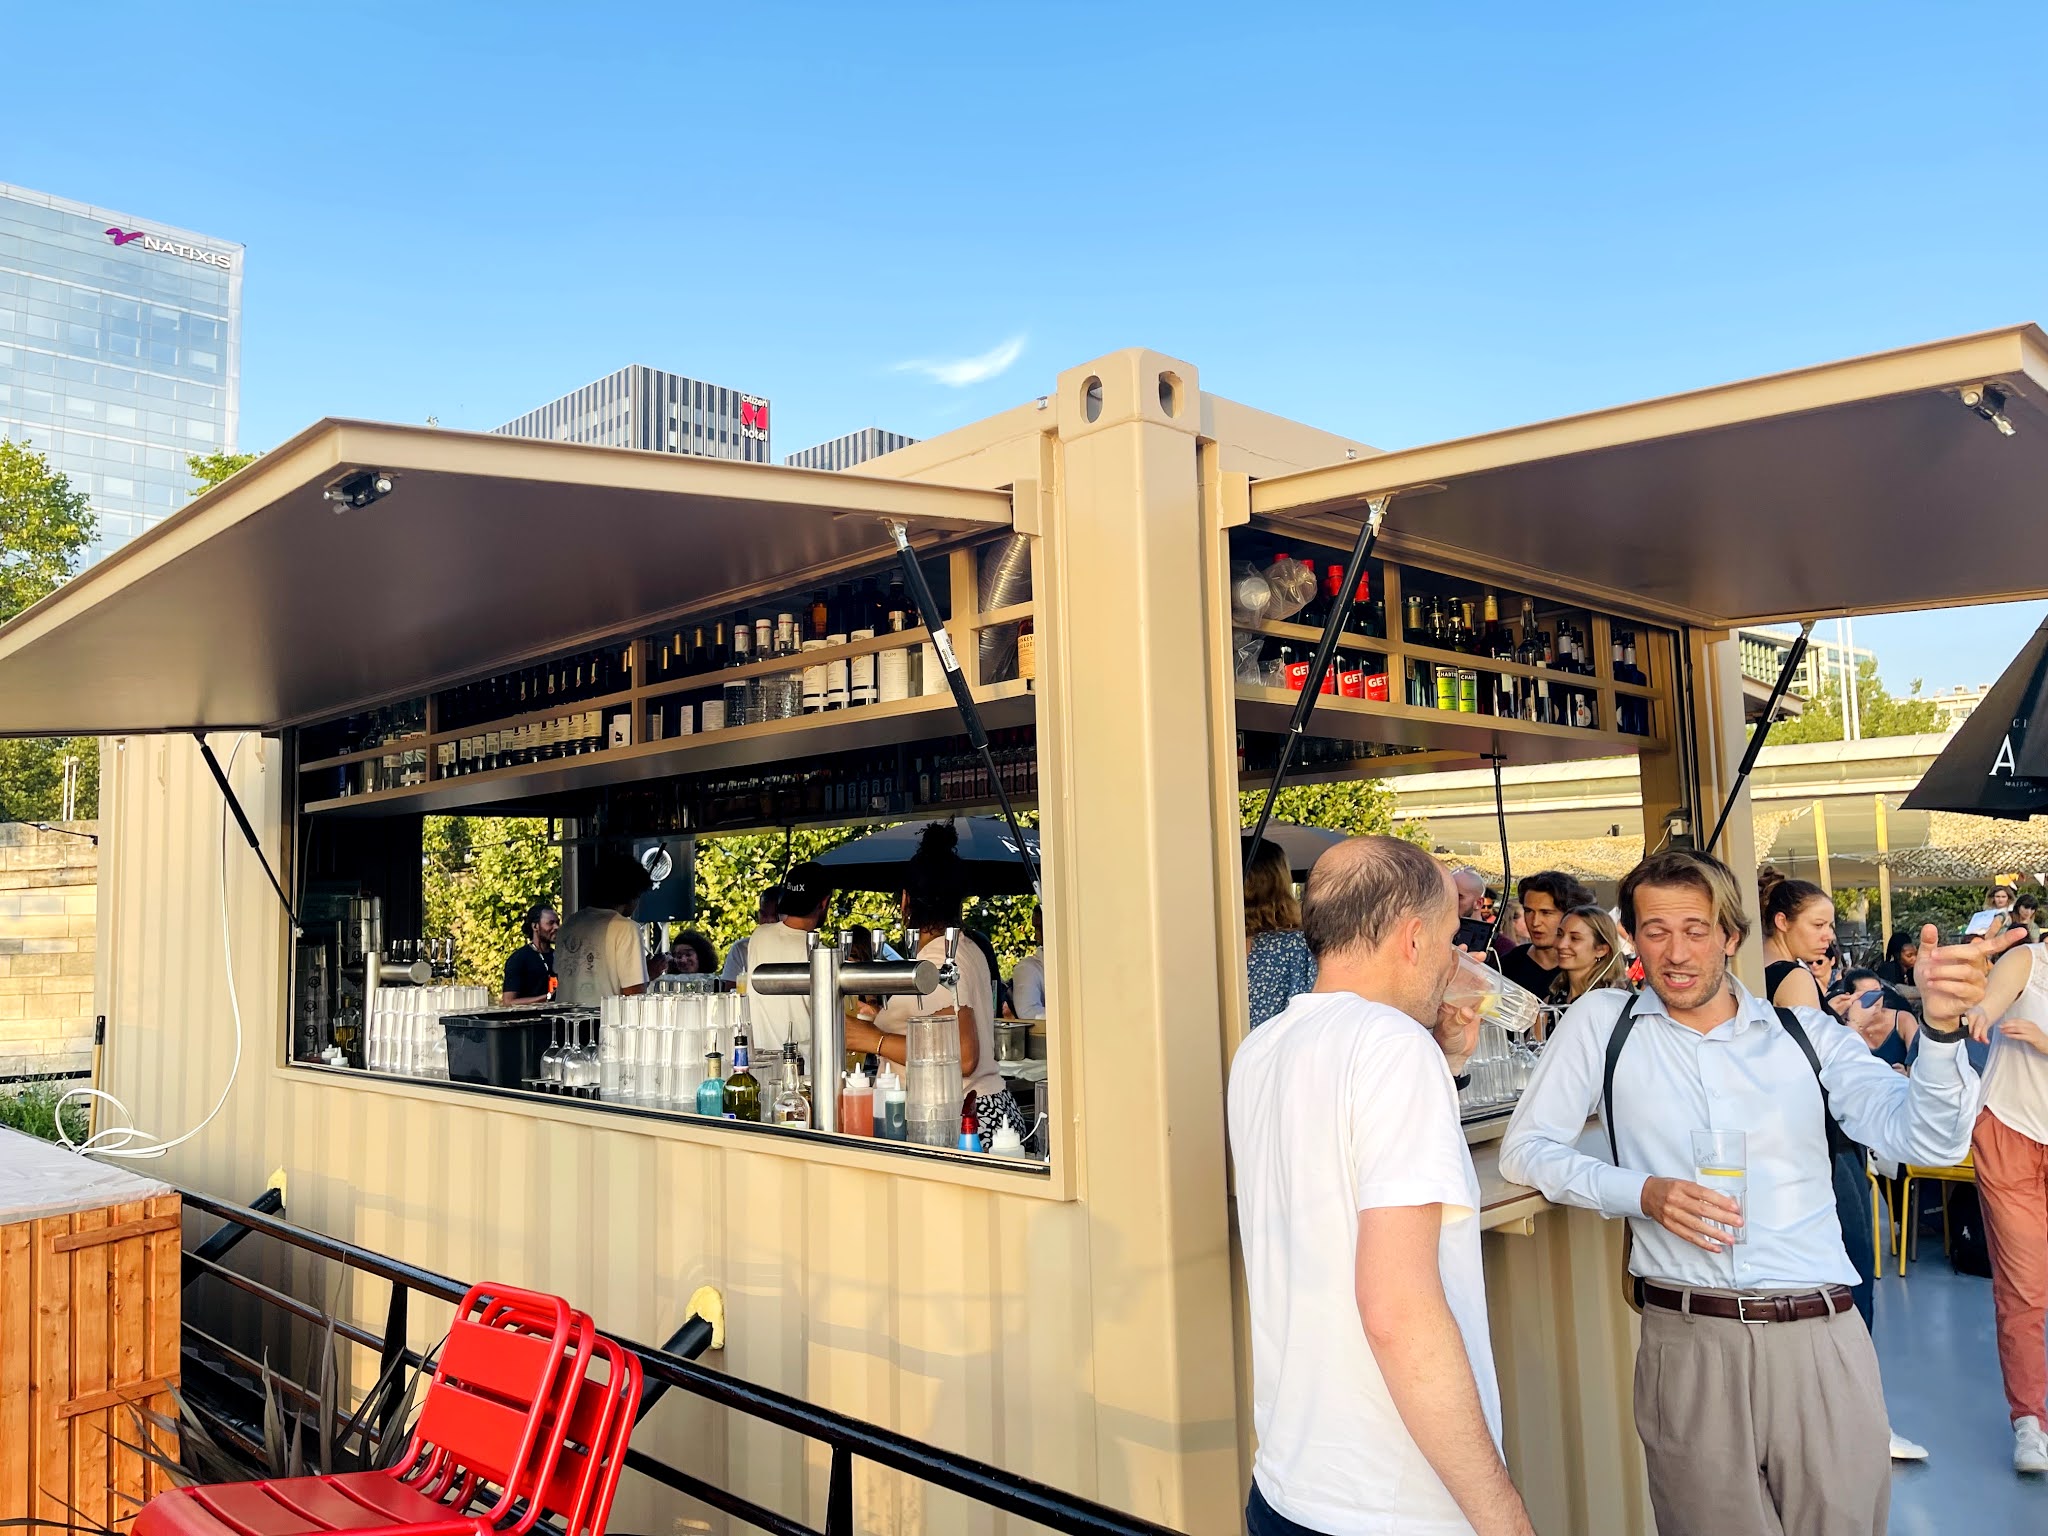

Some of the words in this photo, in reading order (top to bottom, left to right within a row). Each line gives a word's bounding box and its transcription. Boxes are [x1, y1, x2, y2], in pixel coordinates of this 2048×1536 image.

[144, 236, 230, 268] NATIXIS
[742, 395, 767, 407] citizen
[742, 425, 768, 441] hotel
[1293, 665, 1309, 677] GET
[1344, 673, 1362, 684] GET
[1368, 676, 1387, 687] GET
